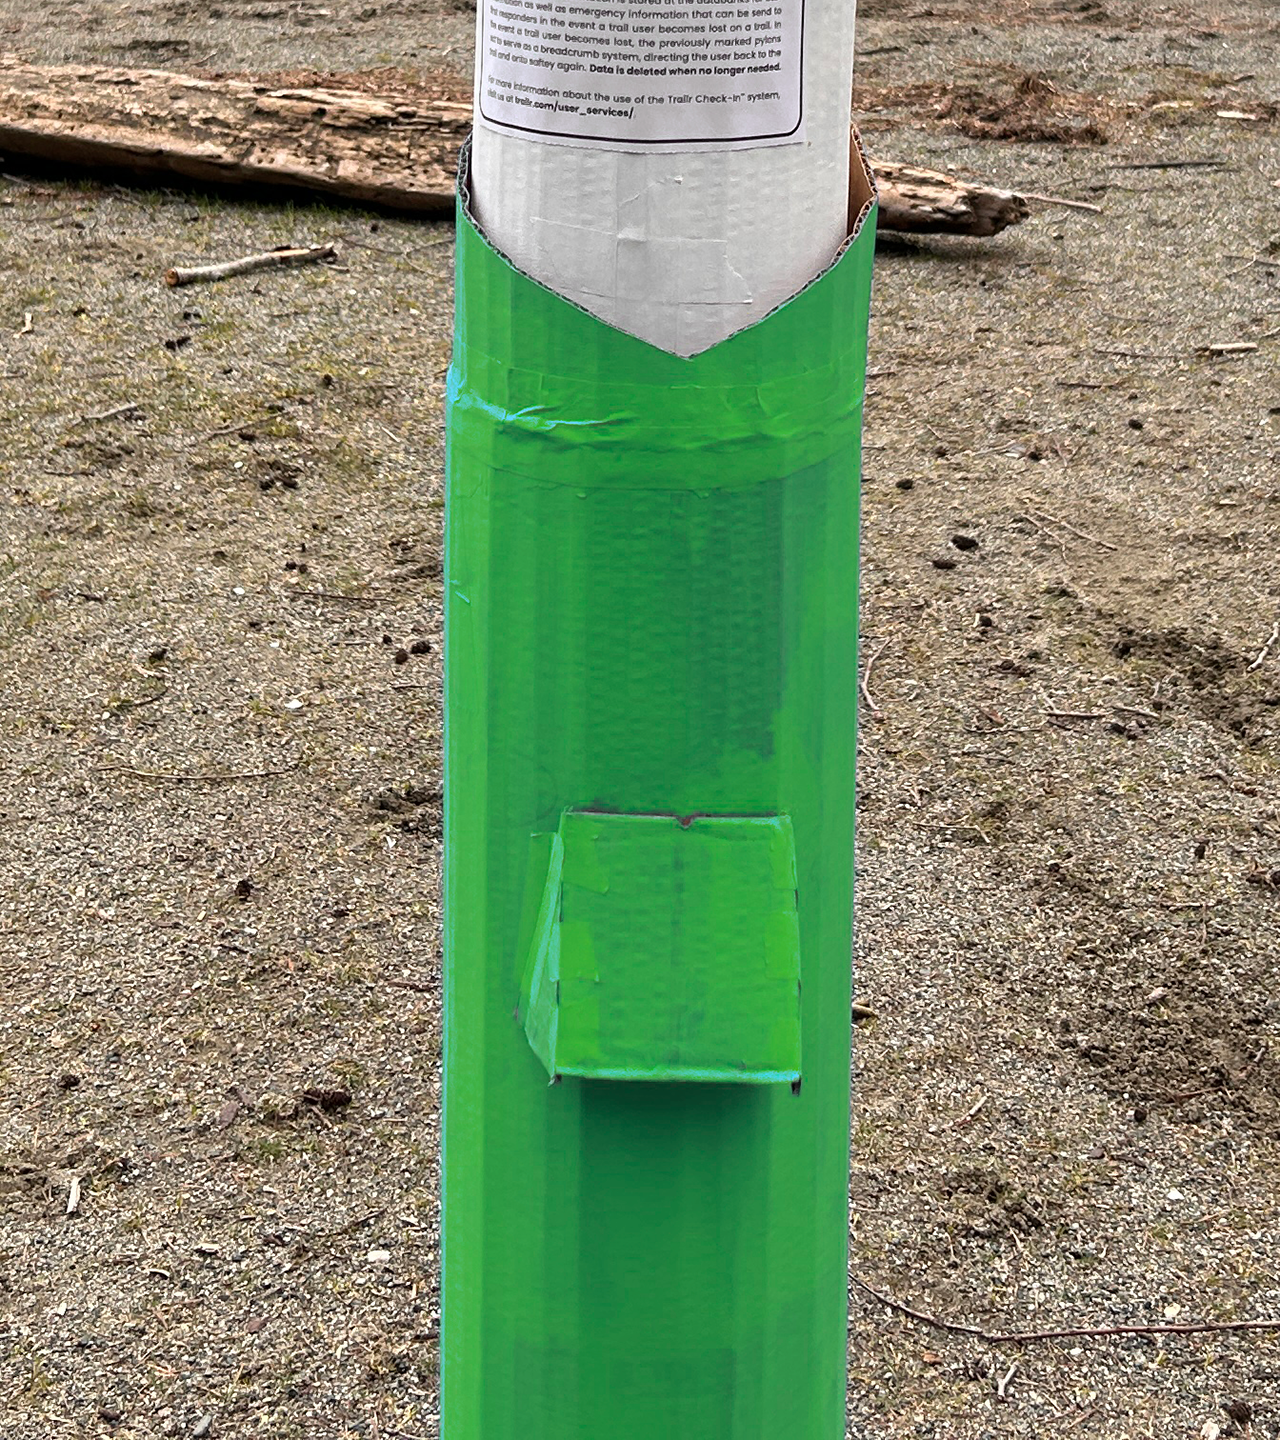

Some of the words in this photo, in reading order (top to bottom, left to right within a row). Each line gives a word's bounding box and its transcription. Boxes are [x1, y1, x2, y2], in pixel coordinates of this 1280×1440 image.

[524, 1, 534, 9] as
[536, 2, 553, 12] well
[555, 5, 566, 14] as
[569, 7, 625, 20] emergency
[628, 9, 688, 19] information
[692, 10, 713, 19] that
[715, 11, 734, 19] can
[737, 9, 749, 18] be
[752, 7, 772, 18] send
[774, 7, 782, 16] to
[540, 15, 548, 25] in
[550, 17, 566, 27] the
[568, 21, 596, 31] event
[598, 23, 606, 31] a
[608, 23, 629, 32] trail
[632, 25, 654, 33] user
[658, 24, 705, 34] becomes
[708, 24, 727, 33] lost
[524, 28, 539, 38] trail
[542, 32, 561, 40] user
[565, 33, 610, 45] becomes
[614, 37, 634, 48] lost,
[638, 39, 655, 47] the
[659, 38, 711, 50] previously
[714, 36, 751, 47] marked
[755, 35, 781, 47] pylons
[540, 45, 599, 59] breadcrumb
[602, 50, 641, 62] system,
[644, 52, 689, 64] directing
[691, 52, 708, 61] the
[710, 52, 731, 61] user
[734, 51, 756, 60] back
[758, 50, 766, 58] to
[768, 49, 782, 58] the
[556, 61, 587, 73] again.
[589, 63, 614, 74] Data
[616, 64, 624, 75] is
[626, 65, 667, 76] deleted
[668, 66, 697, 75] when
[699, 67, 712, 75] no
[714, 66, 745, 77] longer
[747, 62, 781, 73] needed.
[513, 81, 560, 98] information
[562, 89, 591, 101] about
[594, 92, 610, 102] the
[612, 95, 632, 104] use
[634, 94, 645, 104] of
[647, 95, 664, 104] the
[747, 91, 780, 103] system,
